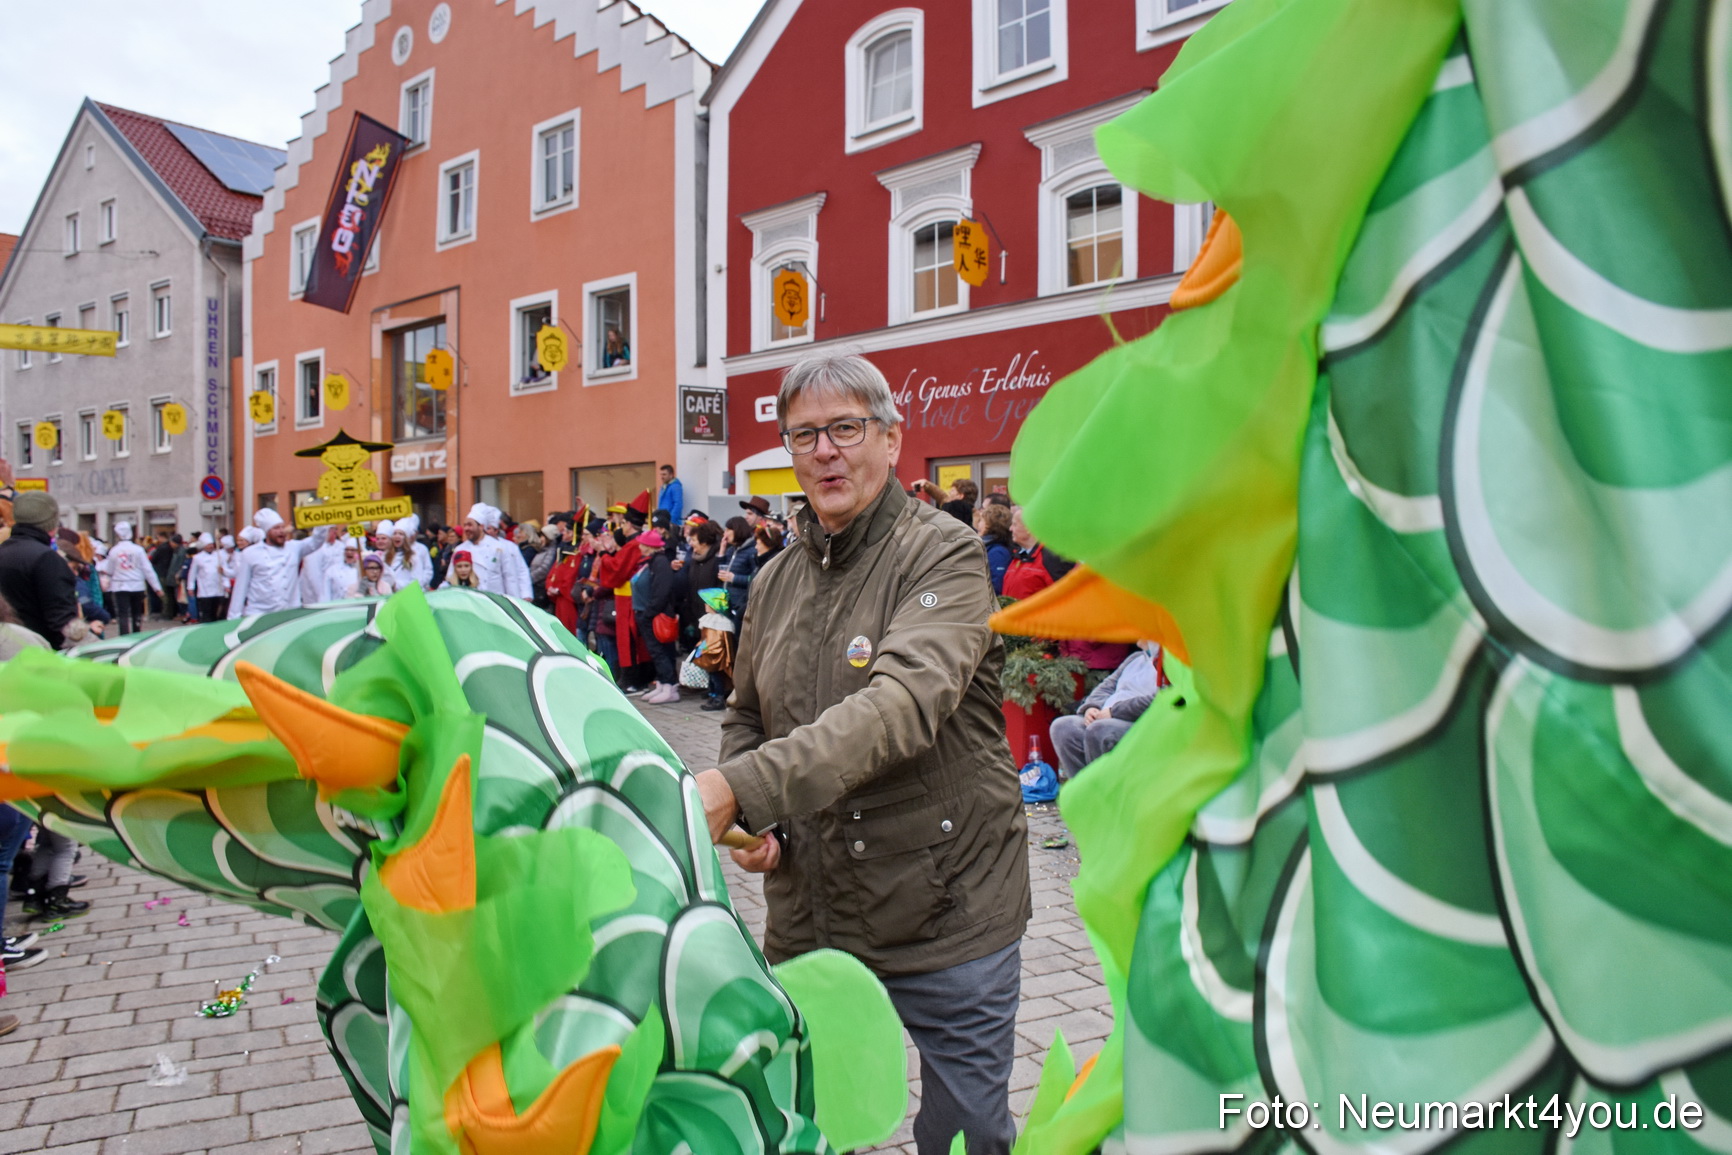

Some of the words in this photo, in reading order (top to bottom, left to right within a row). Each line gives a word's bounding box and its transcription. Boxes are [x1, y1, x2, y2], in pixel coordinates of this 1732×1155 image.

[208, 299, 218, 368] UHREN
[889, 368, 918, 407] ode
[918, 376, 973, 414] Genuss
[979, 350, 1052, 394] Erlebnis
[685, 394, 721, 415] CAFÉ
[207, 378, 219, 475] SCHMUCK
[303, 508, 353, 522] Kolping
[355, 504, 403, 517] Dietfurt
[348, 526, 363, 537] 33
